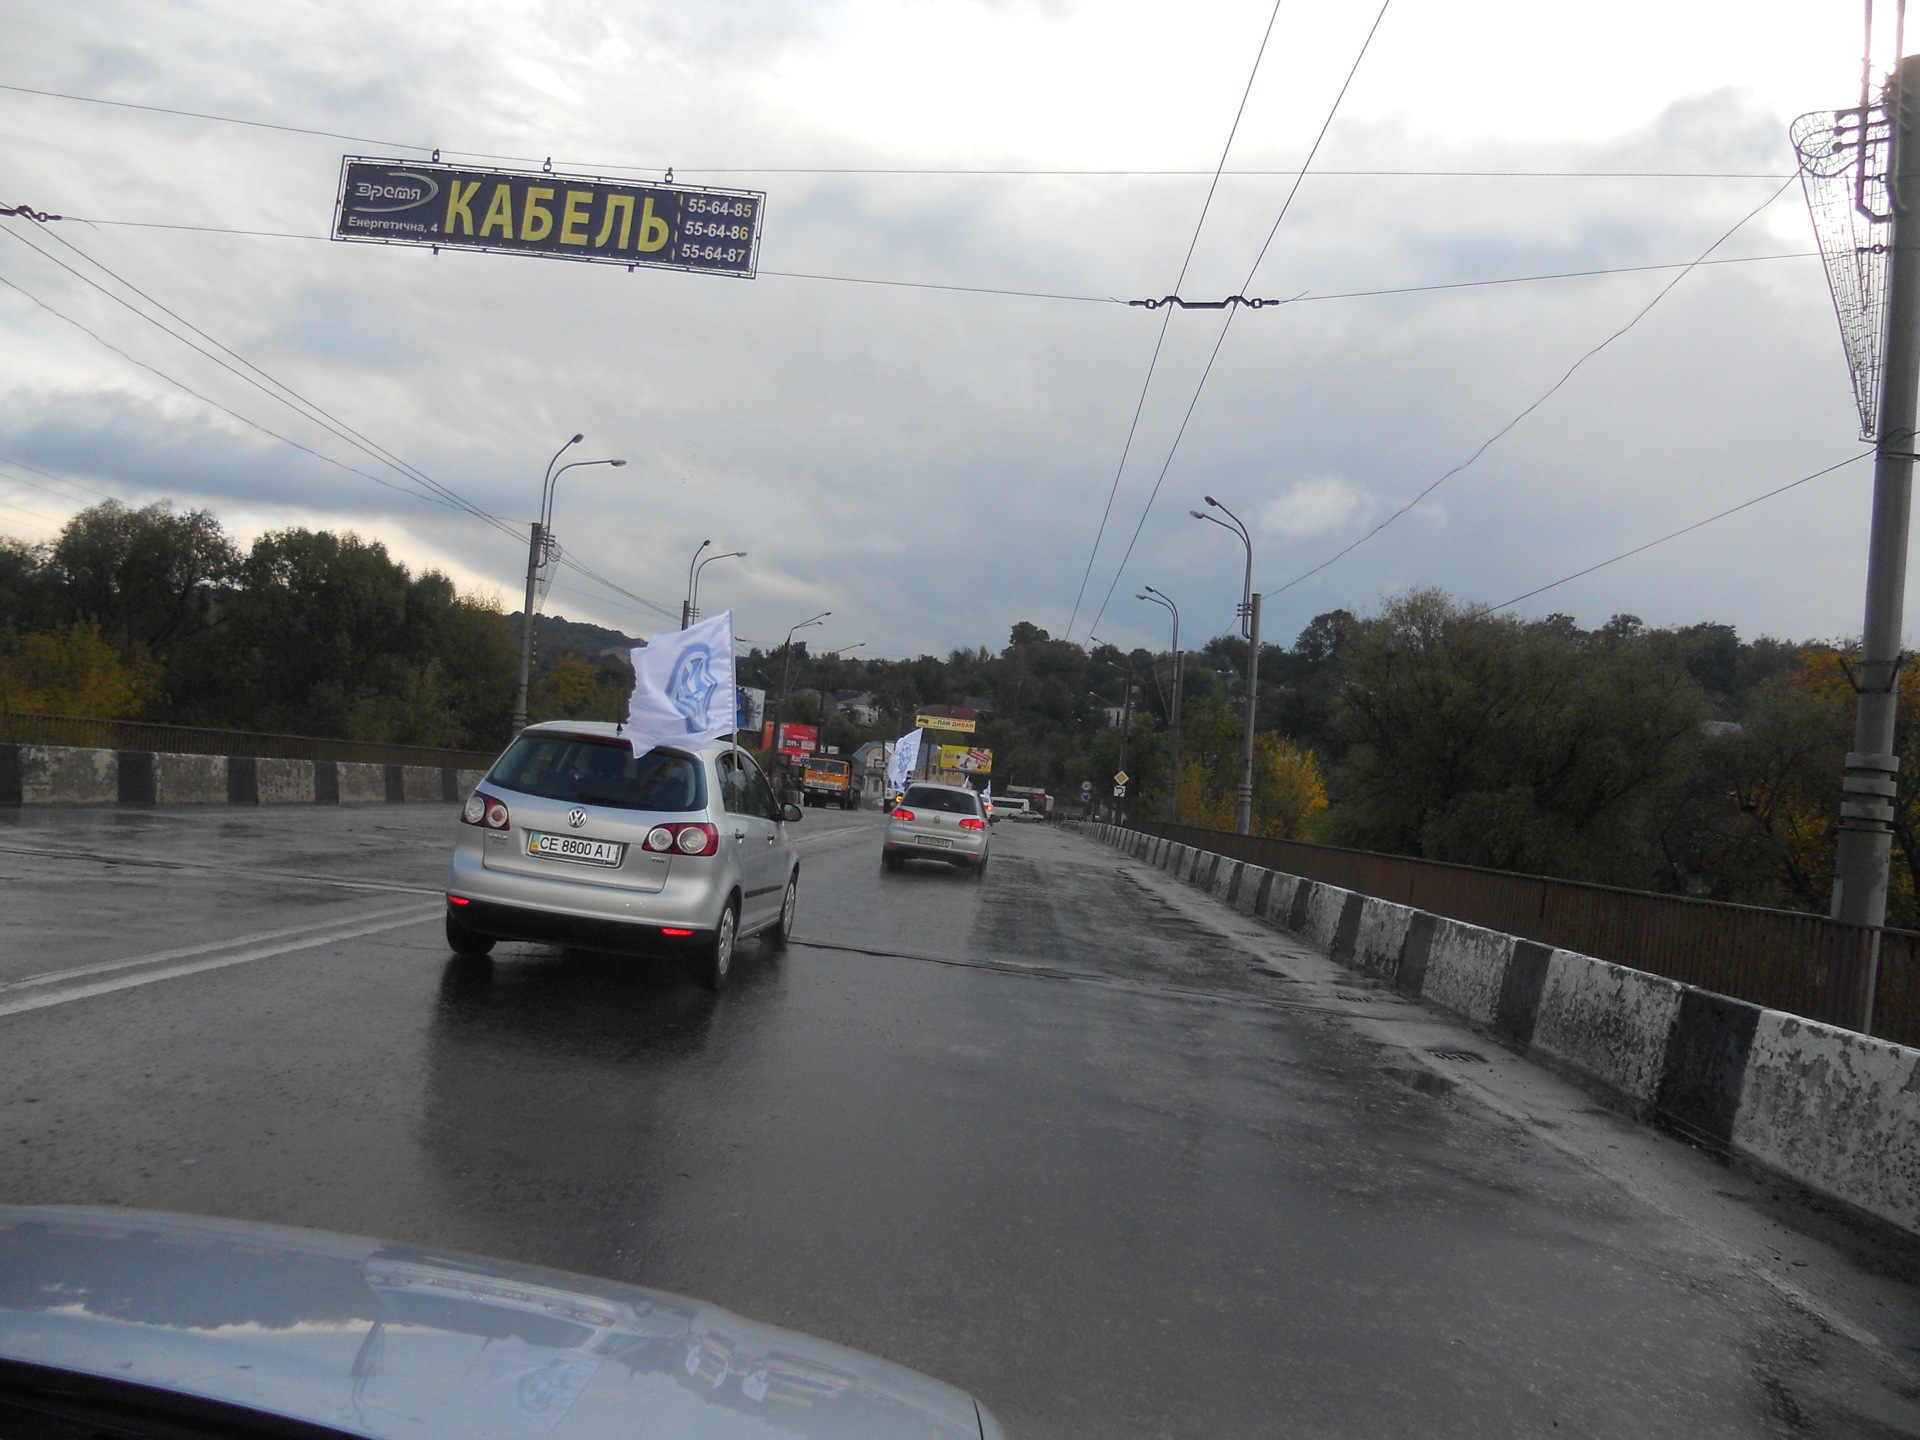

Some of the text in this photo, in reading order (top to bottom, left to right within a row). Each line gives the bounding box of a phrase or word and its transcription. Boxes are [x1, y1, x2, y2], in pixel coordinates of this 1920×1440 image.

[444, 180, 669, 252] КАБЕЛЬ
[688, 198, 752, 218] 55-64-85
[348, 216, 438, 233] Енергетична, 4
[684, 221, 749, 240] 55-64-86
[681, 244, 746, 263] 55-64-87
[937, 719, 951, 727] ПАН
[951, 721, 974, 729] ДИВАН
[540, 836, 559, 851] CE
[562, 840, 592, 856] 8800
[594, 846, 612, 859] AI
